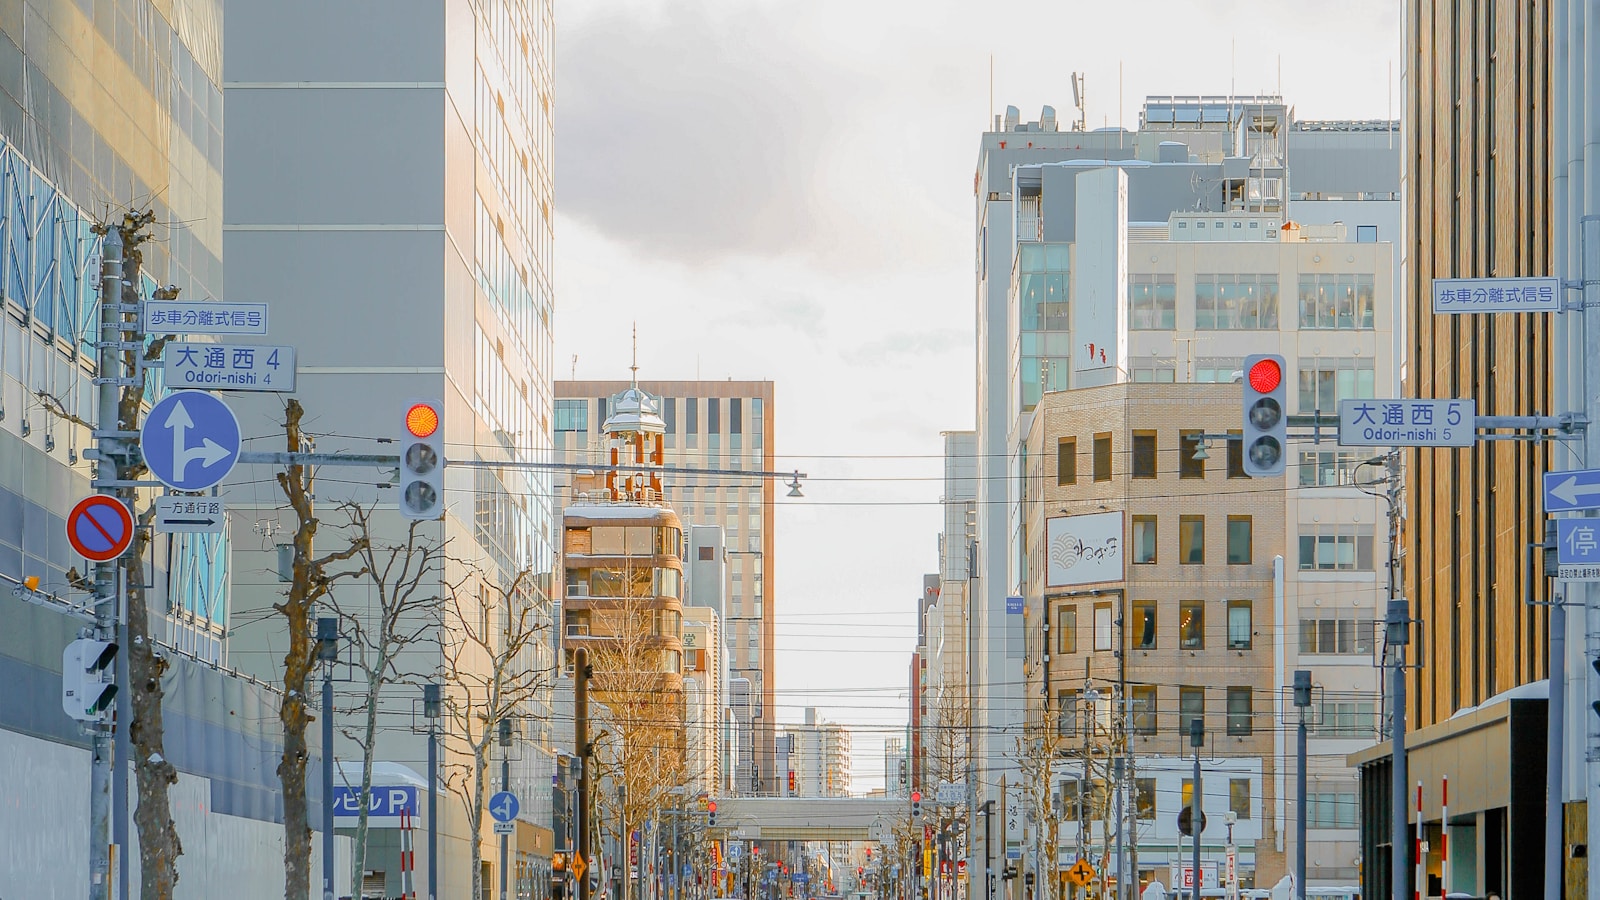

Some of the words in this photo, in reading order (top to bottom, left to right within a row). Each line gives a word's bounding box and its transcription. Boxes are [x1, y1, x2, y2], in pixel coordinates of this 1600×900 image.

[1440, 286, 1553, 304] 歩車分離式信号
[151, 310, 262, 327] 歩車分離式信号
[175, 345, 256, 370] 大通西
[266, 348, 280, 370] 4
[185, 370, 257, 385] Odori-nishi
[263, 373, 271, 385] 4
[1352, 402, 1434, 425] 大通西
[1447, 402, 1461, 426] 5
[1363, 427, 1437, 441] Odori-nishi
[1443, 428, 1452, 441] 5
[160, 501, 220, 515] 一方通行路
[1565, 525, 1598, 557] 停
[388, 789, 409, 814] P
